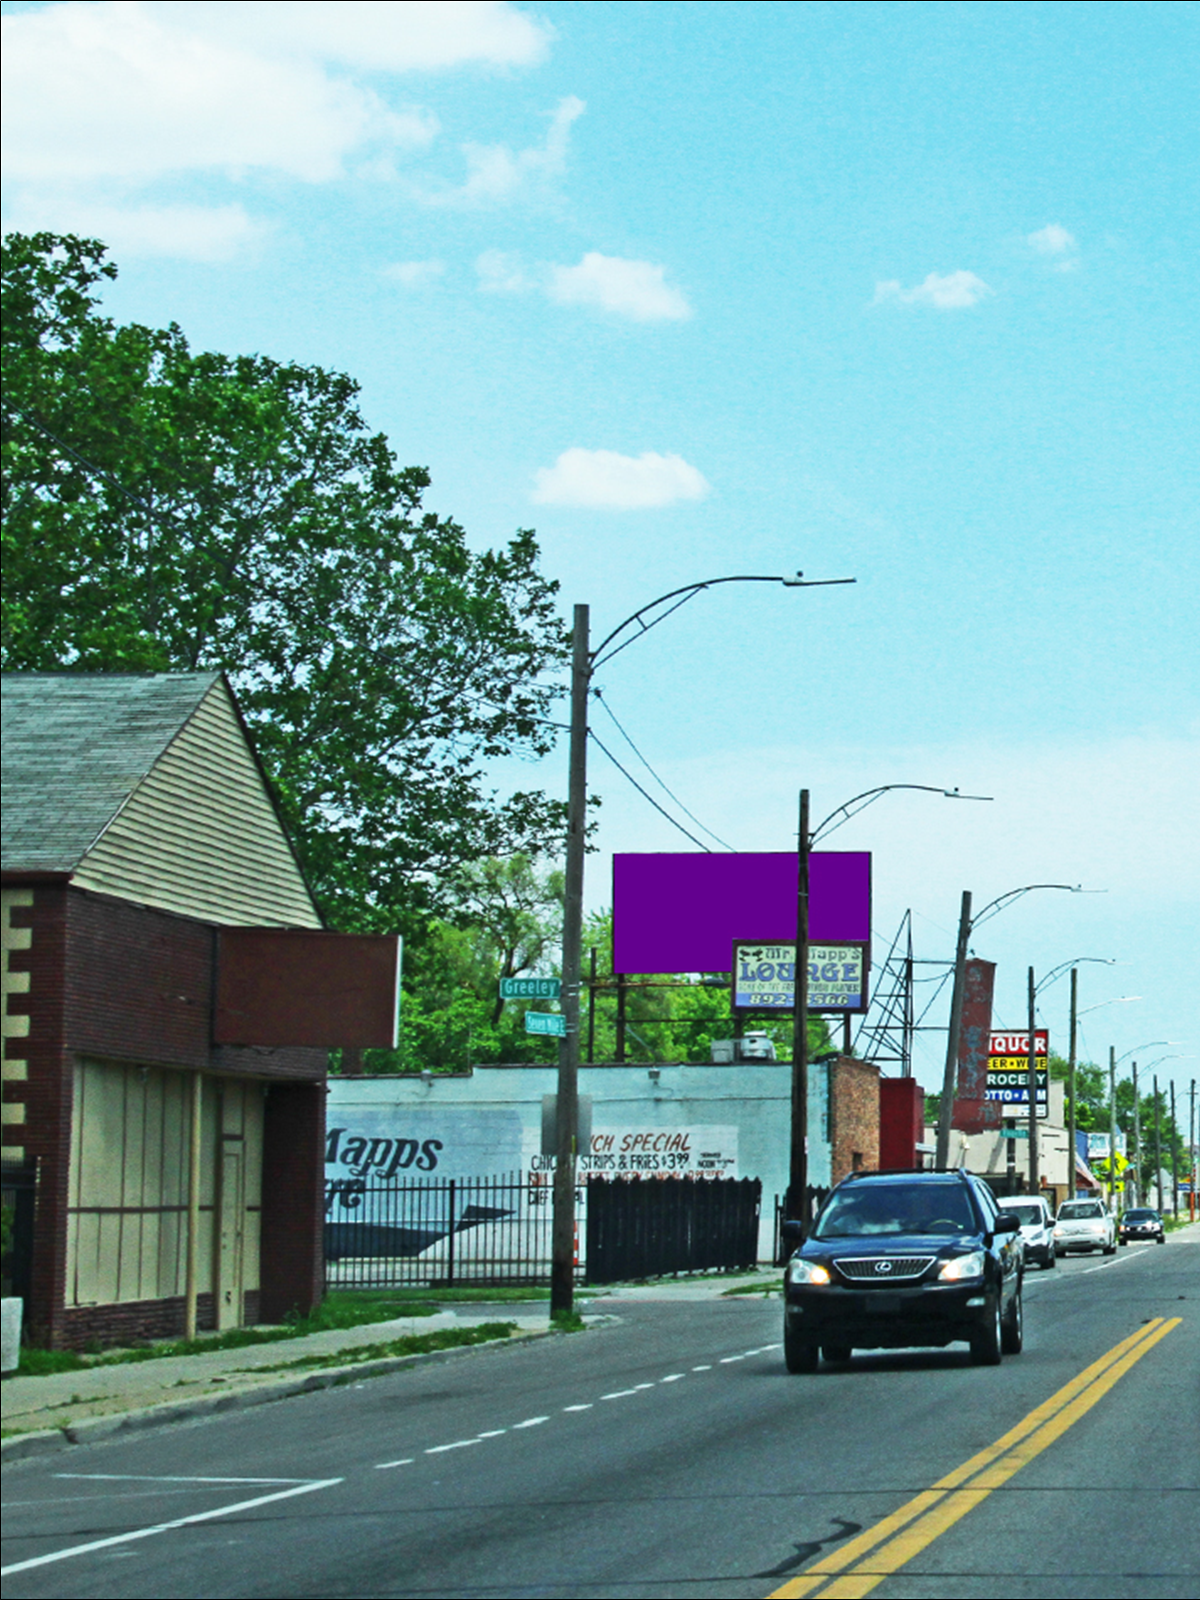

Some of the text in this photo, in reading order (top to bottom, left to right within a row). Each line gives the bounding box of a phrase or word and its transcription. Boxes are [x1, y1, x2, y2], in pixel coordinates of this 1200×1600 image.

[505, 979, 557, 998] Greeley
[989, 1037, 1046, 1052] IQUOR
[987, 1074, 1046, 1086] ROCEY
[985, 1091, 1047, 1101] OTTO AM
[620, 1132, 691, 1152] SPECIAL
[580, 1155, 615, 1170] STRIPS
[618, 1154, 628, 1170] &
[630, 1154, 660, 1170] FRIES
